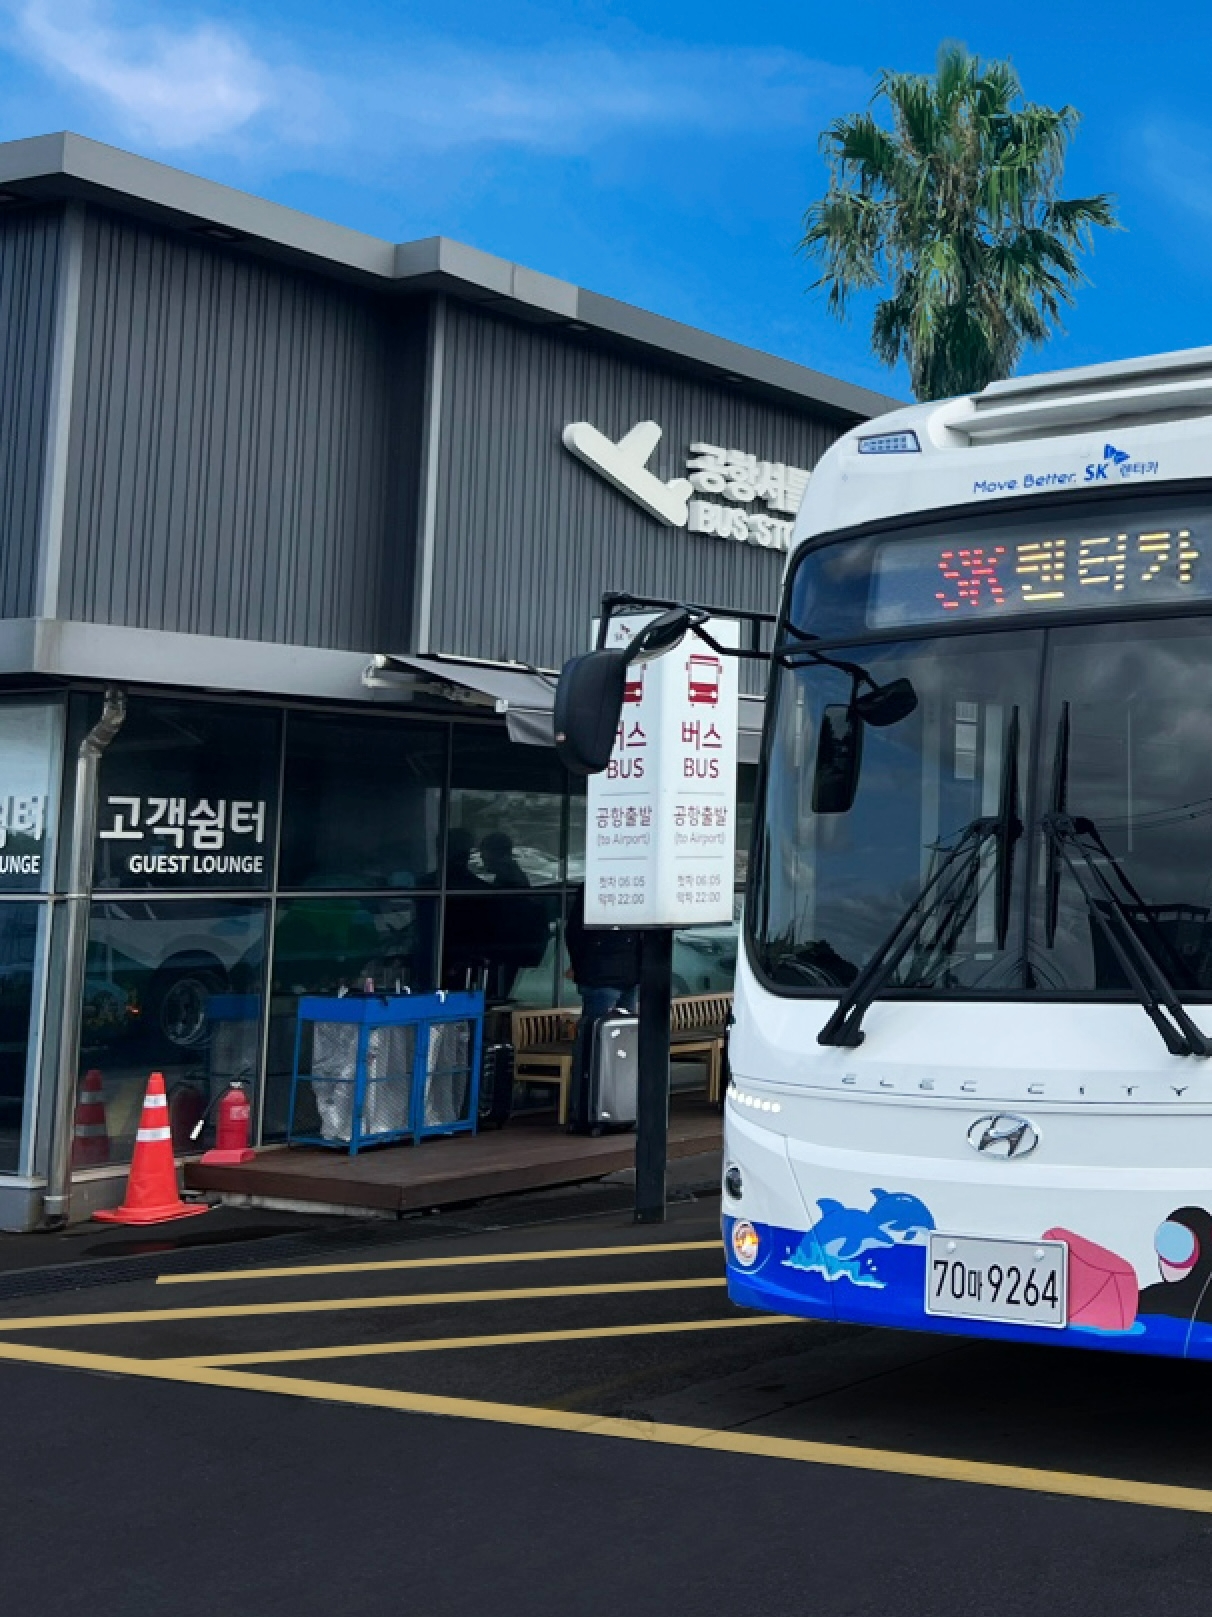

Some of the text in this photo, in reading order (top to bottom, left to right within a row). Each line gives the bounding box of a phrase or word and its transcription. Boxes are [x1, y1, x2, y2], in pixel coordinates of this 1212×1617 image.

[1084, 463, 1108, 481] SK
[688, 500, 748, 540] BUS
[682, 720, 722, 751] 버스
[607, 758, 645, 779] BUS
[683, 758, 719, 779] BUS
[99, 795, 266, 849] 고객쉼터
[596, 806, 652, 828] 공항출발
[674, 806, 728, 827] 공항출발
[129, 855, 264, 874] GUEST LOUNGE
[842, 1073, 1189, 1097] ELEC CITY
